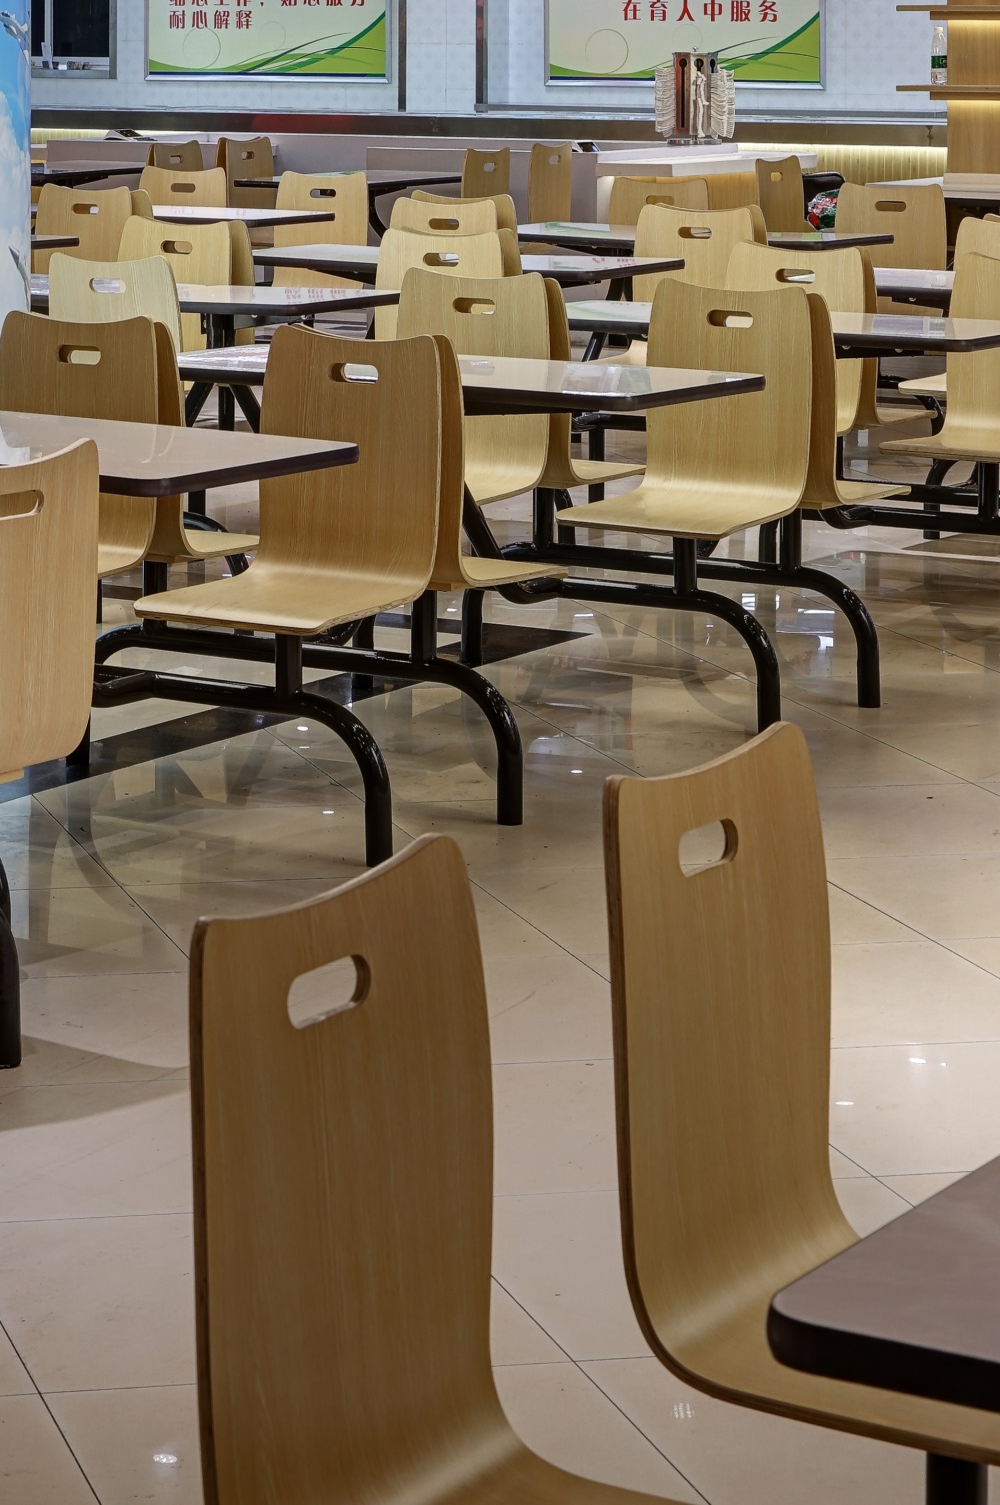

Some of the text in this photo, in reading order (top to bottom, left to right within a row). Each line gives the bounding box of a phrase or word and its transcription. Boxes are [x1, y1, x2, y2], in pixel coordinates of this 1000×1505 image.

[169, 10, 253, 30] 耐心解释
[622, 0, 779, 23] 在育人中服务
